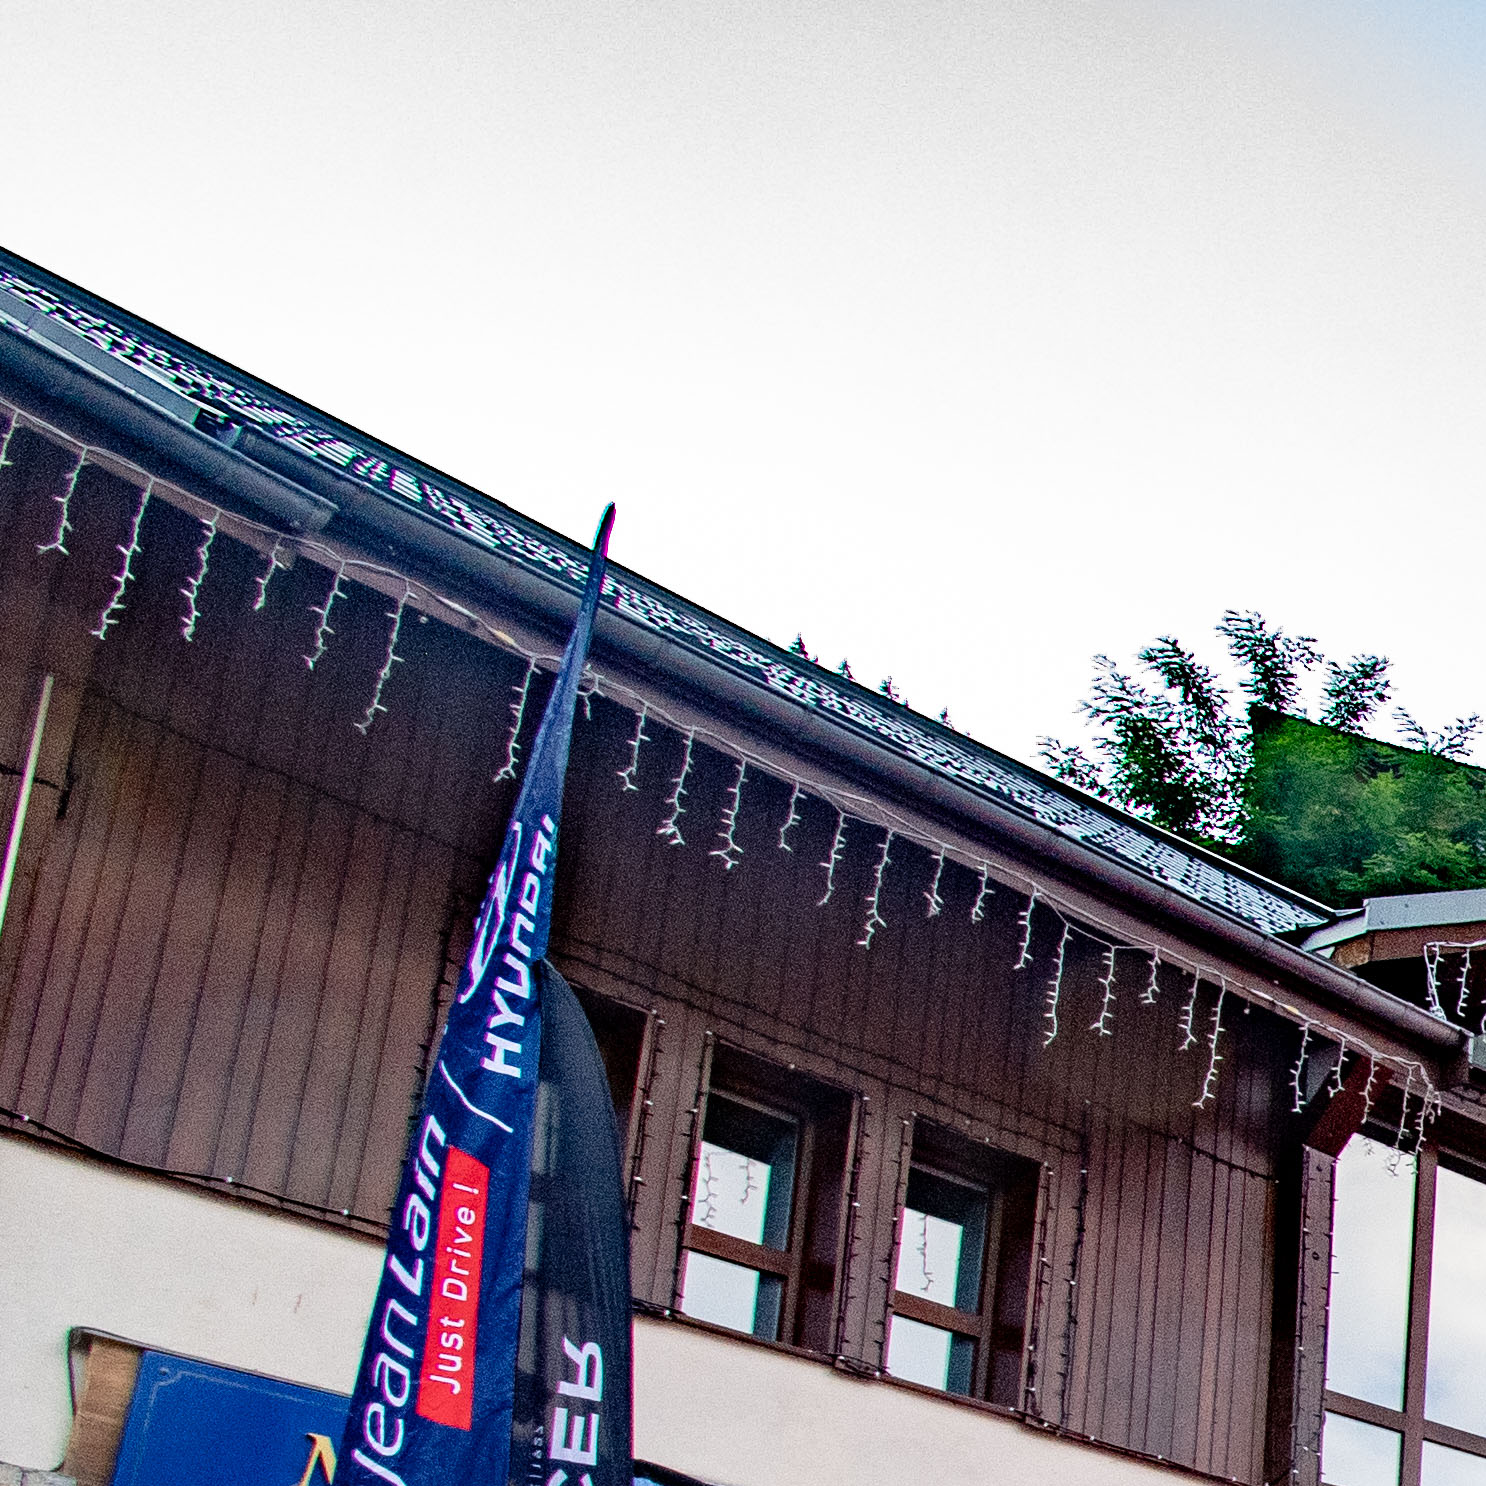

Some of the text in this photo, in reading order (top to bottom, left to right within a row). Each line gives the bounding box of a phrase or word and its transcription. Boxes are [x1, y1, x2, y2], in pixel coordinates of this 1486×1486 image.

[480, 813, 559, 1078] HYUNDAI
[441, 1205, 477, 1299] Drive
[428, 1317, 469, 1395] Just
